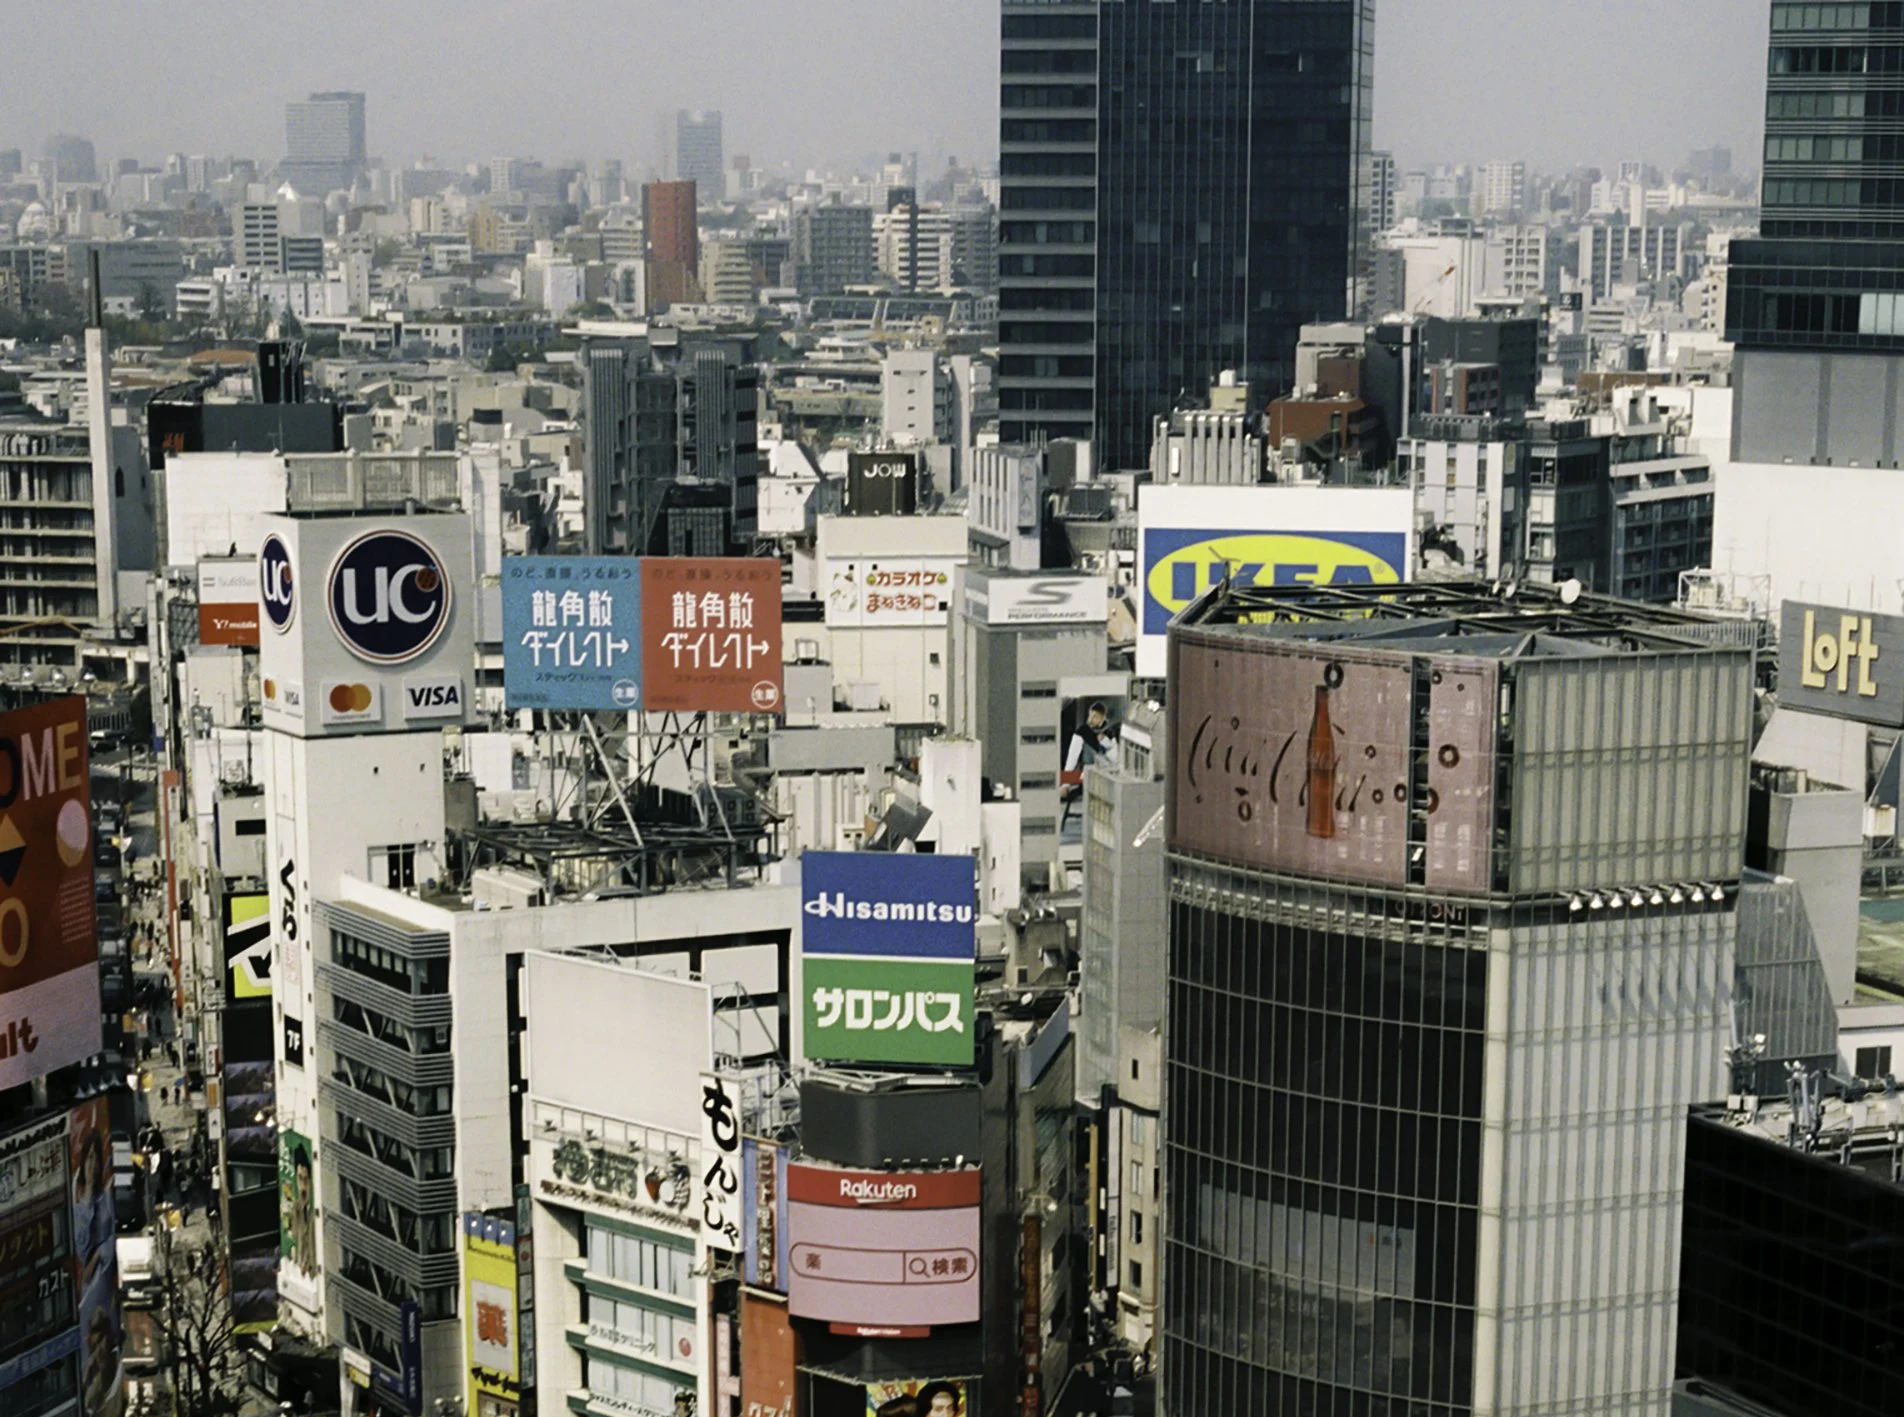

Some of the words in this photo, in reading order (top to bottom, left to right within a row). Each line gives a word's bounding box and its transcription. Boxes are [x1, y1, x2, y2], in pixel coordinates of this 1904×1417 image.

[864, 463, 906, 478] JOW
[876, 571, 938, 587] カラオケ
[531, 589, 613, 627] 龍角散
[672, 591, 753, 629] 龍角散
[866, 593, 937, 613] まねきねこ
[521, 630, 630, 668] ダイレクト
[661, 632, 770, 670] ダイレクト
[409, 686, 459, 707] VISA
[804, 892, 972, 923] Hisamitsu
[813, 987, 964, 1033] サロンパス
[703, 1077, 739, 1246] もんじゃ
[840, 1179, 917, 1200] Rakuten
[932, 1257, 968, 1275] 検索
